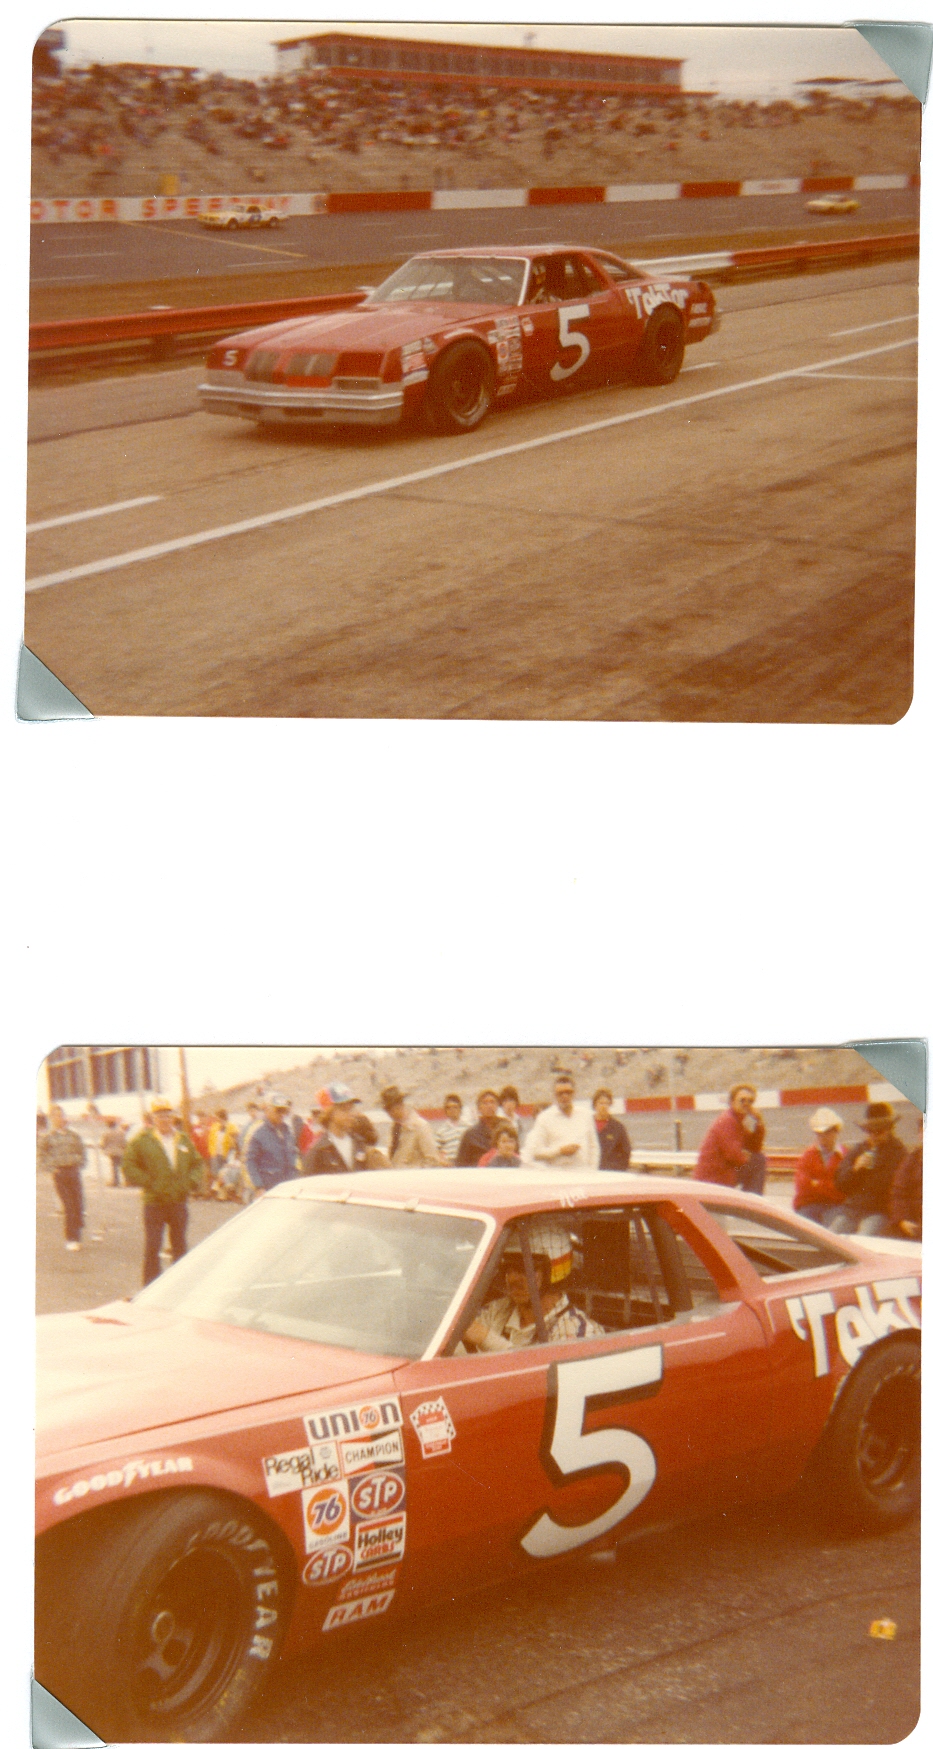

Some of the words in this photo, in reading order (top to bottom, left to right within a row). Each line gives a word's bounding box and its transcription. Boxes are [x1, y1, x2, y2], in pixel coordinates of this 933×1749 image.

[550, 304, 590, 381] 5
[222, 350, 238, 366] 5
[264, 1449, 315, 1476] Regal
[345, 1441, 399, 1463] CHAMPION
[520, 1345, 662, 1558] 5
[53, 1457, 193, 1505] GOODYEAR
[301, 1461, 339, 1485] Ride
[358, 1476, 397, 1509] STP
[312, 1494, 342, 1528] 76
[358, 1527, 403, 1548] Holley
[310, 1550, 346, 1580] STP
[330, 1595, 389, 1620] RAM
